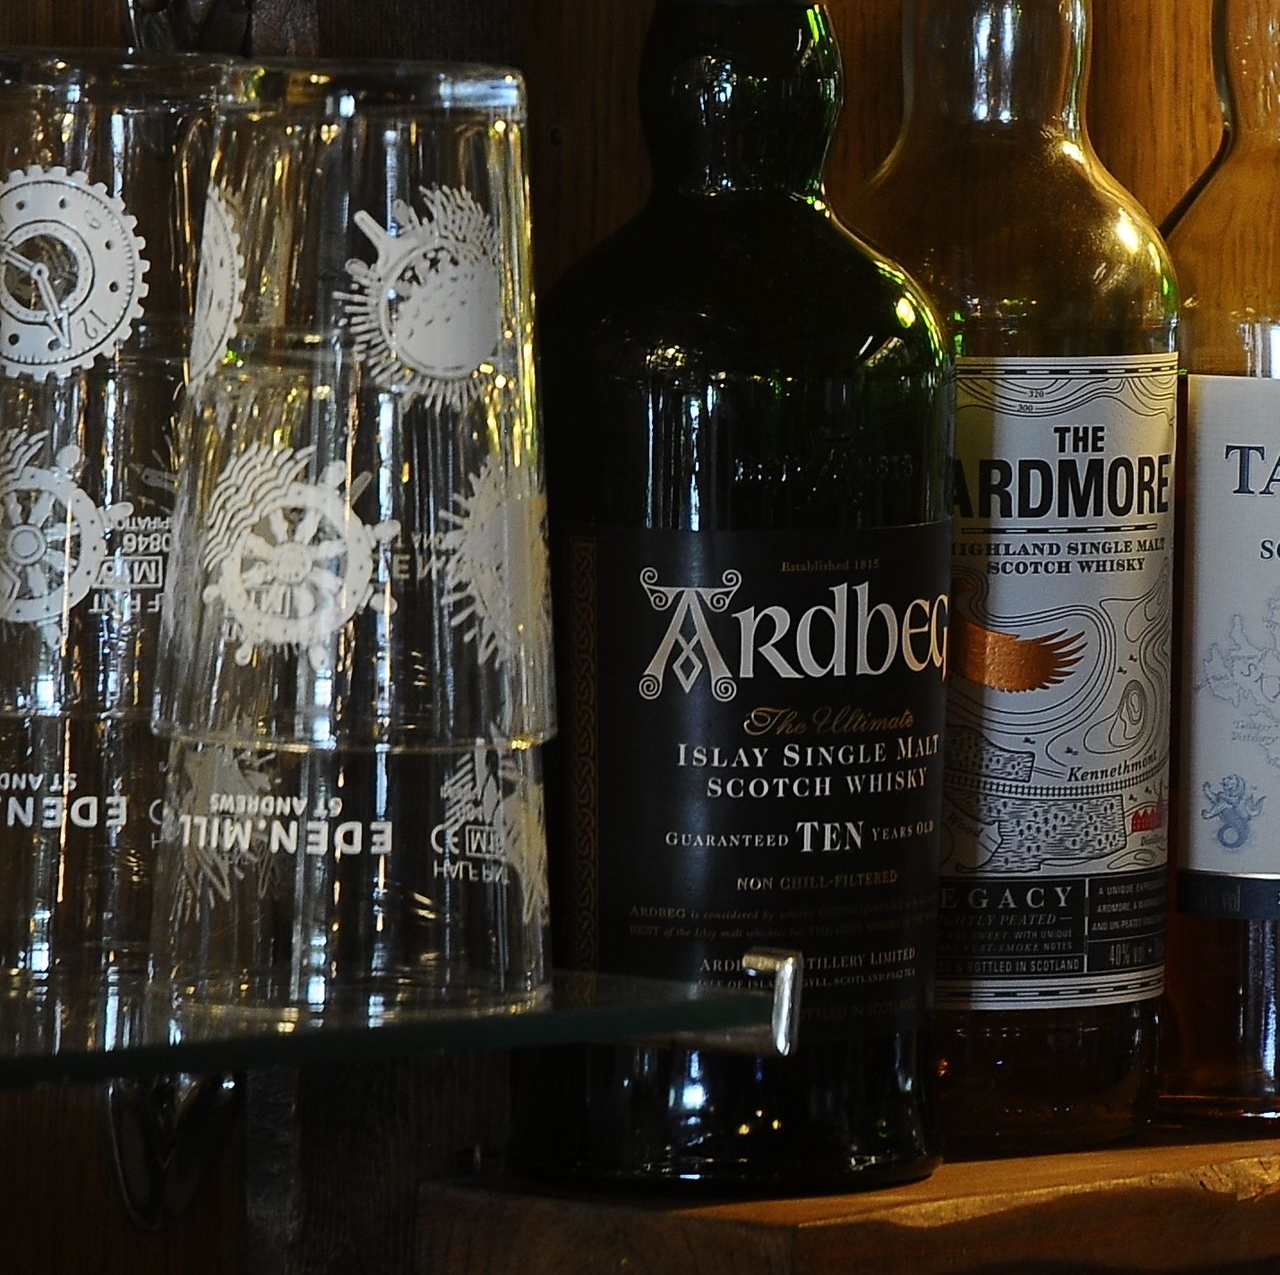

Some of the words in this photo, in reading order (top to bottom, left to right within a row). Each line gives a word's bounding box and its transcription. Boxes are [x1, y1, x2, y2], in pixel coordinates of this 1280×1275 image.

[1054, 426, 1105, 453] THE
[1067, 540, 1132, 555] SINGLE
[1136, 537, 1165, 553] MALT
[988, 560, 1071, 575] SCOTCH
[1077, 557, 1146, 574] WHISKY
[743, 707, 807, 736] The
[811, 705, 914, 734] Ultimate
[677, 743, 769, 767] ISLAY
[783, 743, 887, 767] SINGLE
[897, 734, 939, 760] MALT
[1067, 751, 1157, 783] Kennethmont
[707, 776, 832, 798] SCOTCH
[846, 767, 928, 794] WHISKY
[209, 791, 304, 816] ANDREWS
[665, 831, 789, 847] GUARANTEED
[796, 820, 864, 852] TEN
[871, 824, 912, 841] YEARS
[916, 820, 935, 835] OLD
[736, 877, 774, 891] NON
[780, 870, 898, 890] CHILL-FILTERED
[870, 947, 915, 966] LIMITED
[1031, 958, 1079, 971] SCOTLAND
